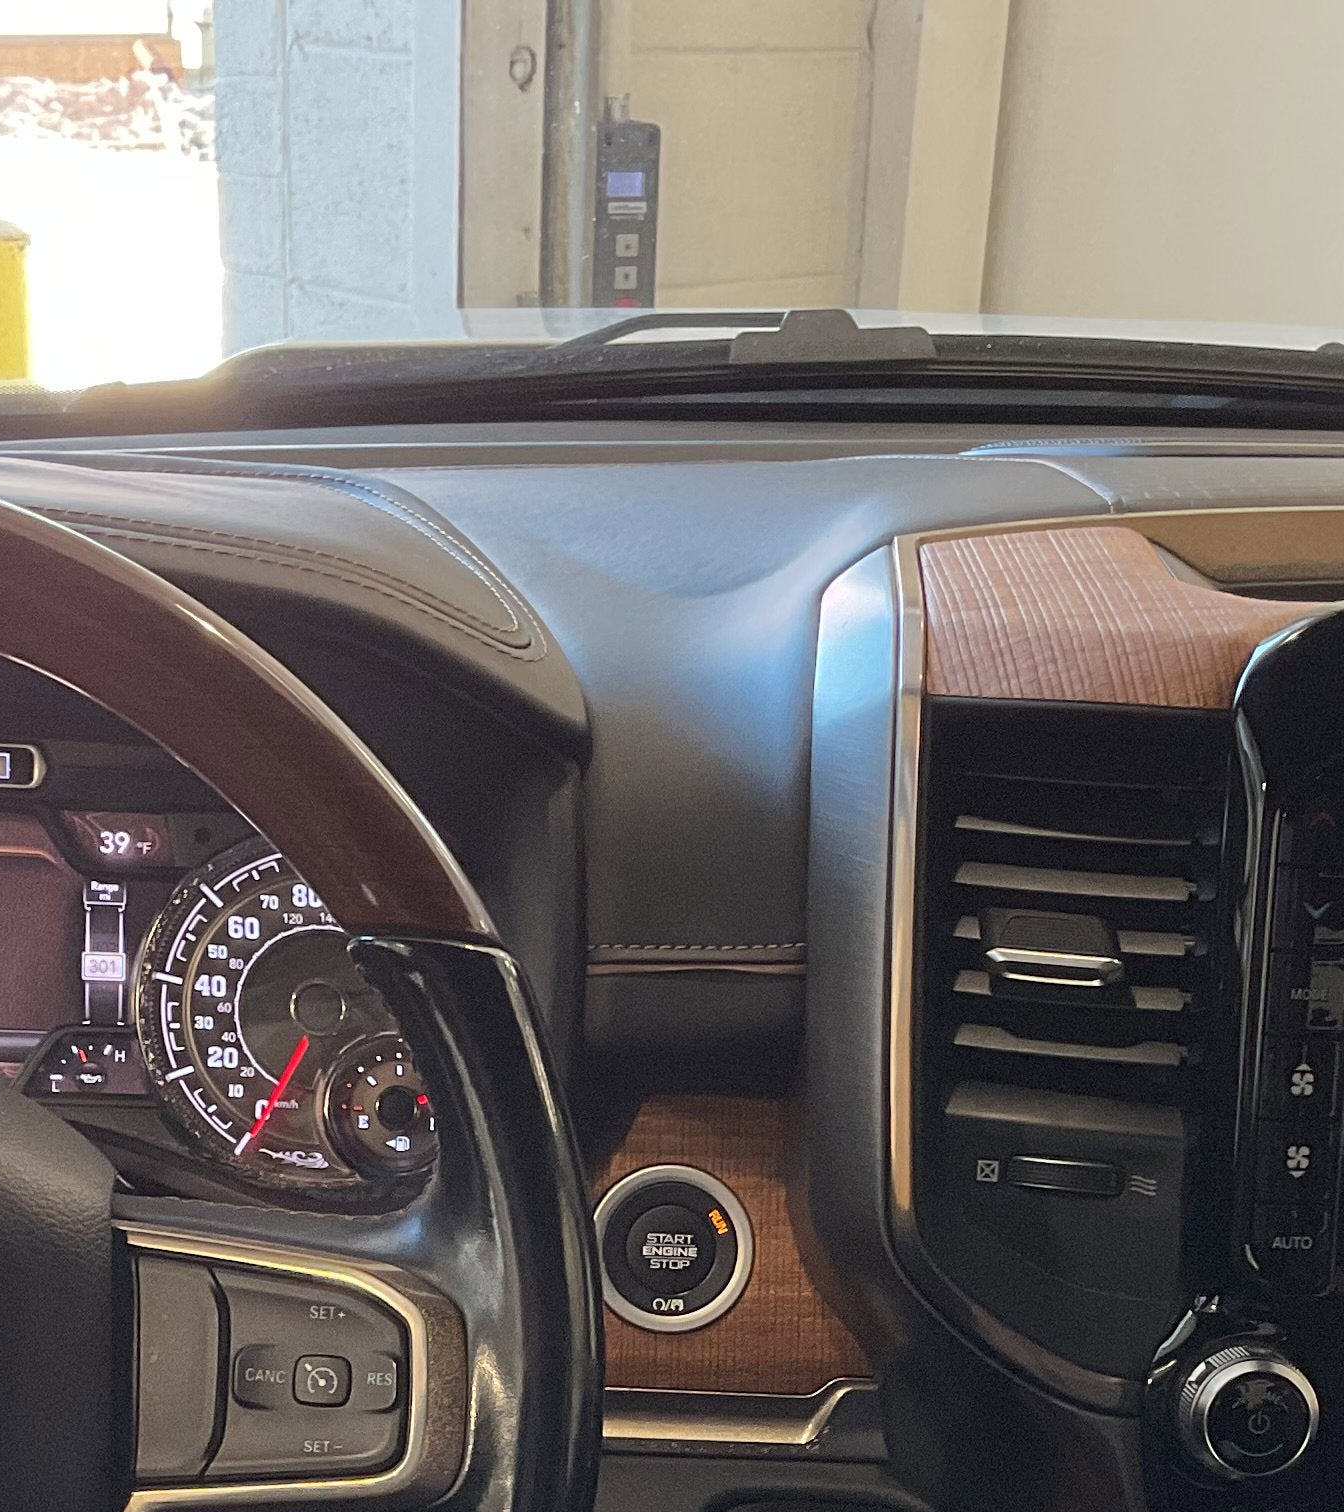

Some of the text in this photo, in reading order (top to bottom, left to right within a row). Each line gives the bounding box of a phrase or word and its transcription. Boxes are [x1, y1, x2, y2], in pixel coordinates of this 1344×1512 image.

[99, 832, 131, 854] 39
[260, 895, 279, 909] 70
[282, 913, 304, 925] 120
[227, 917, 260, 939] 60
[207, 945, 228, 959] 50
[89, 960, 116, 973] 301
[229, 958, 244, 970] 80
[194, 975, 227, 998] 40
[1290, 988, 1329, 1000] MODE
[217, 1002, 232, 1014] 60
[194, 1016, 213, 1030] 30
[221, 1031, 236, 1042] 40
[114, 1050, 126, 1063] H
[207, 1046, 239, 1069] 20
[240, 1066, 255, 1078] 20
[51, 1080, 61, 1093] L
[227, 1083, 245, 1098] 10
[358, 1115, 369, 1129] E
[709, 1208, 729, 1235] RUN
[646, 1232, 694, 1245] START
[1272, 1236, 1313, 1250] AUTO
[642, 1245, 698, 1258] ENGINE
[649, 1258, 691, 1270] STOP
[245, 1367, 286, 1384] CANC
[367, 1371, 393, 1386] RES
